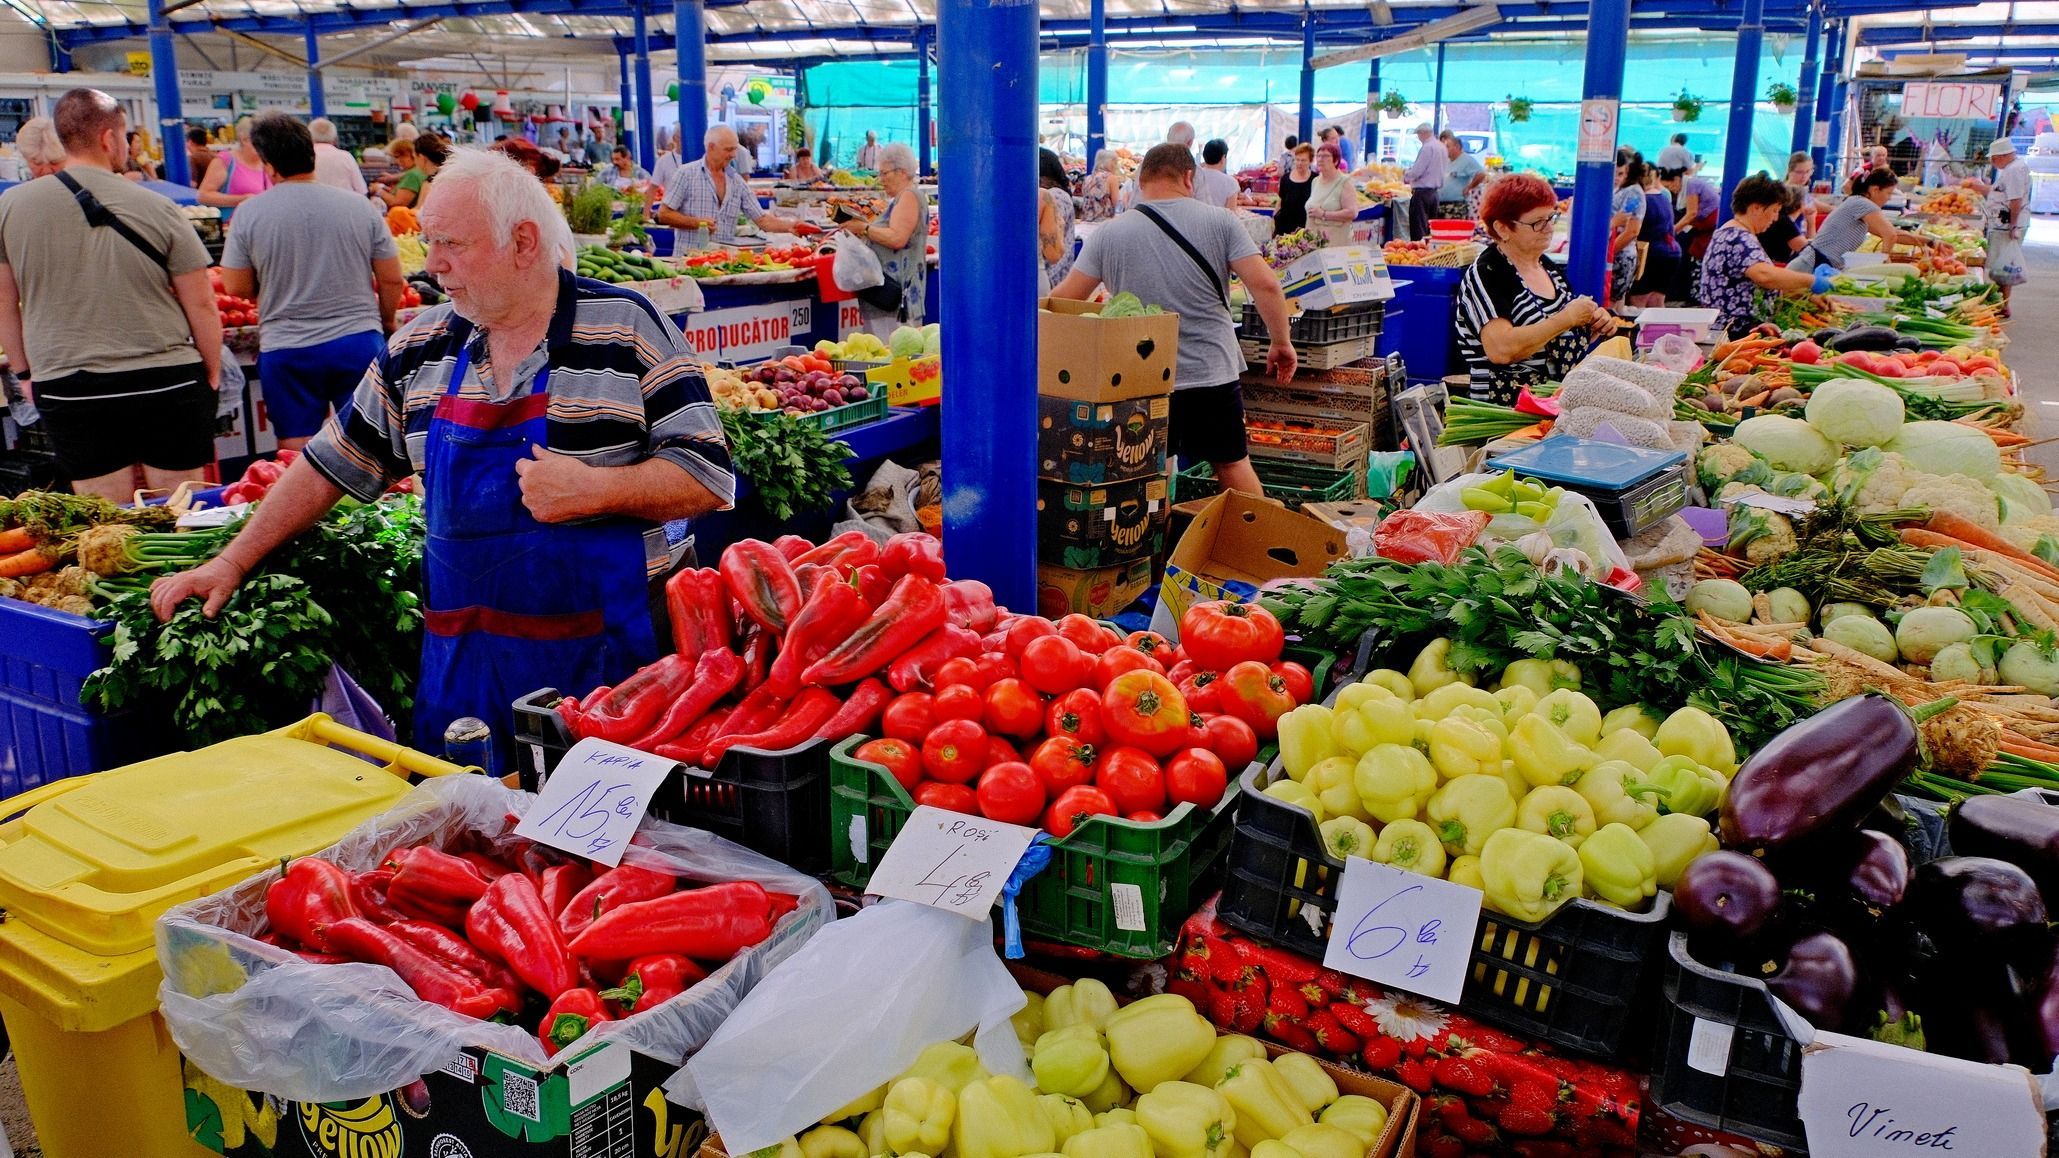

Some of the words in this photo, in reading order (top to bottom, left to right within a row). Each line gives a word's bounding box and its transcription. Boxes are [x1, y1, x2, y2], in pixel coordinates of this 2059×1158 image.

[1903, 84, 1995, 118] FLORI
[686, 316, 790, 353] PRODUCĂTOR
[792, 307, 810, 328] 250
[538, 779, 632, 839] 15
[915, 844, 968, 906] 4
[1345, 885, 1424, 960] 6
